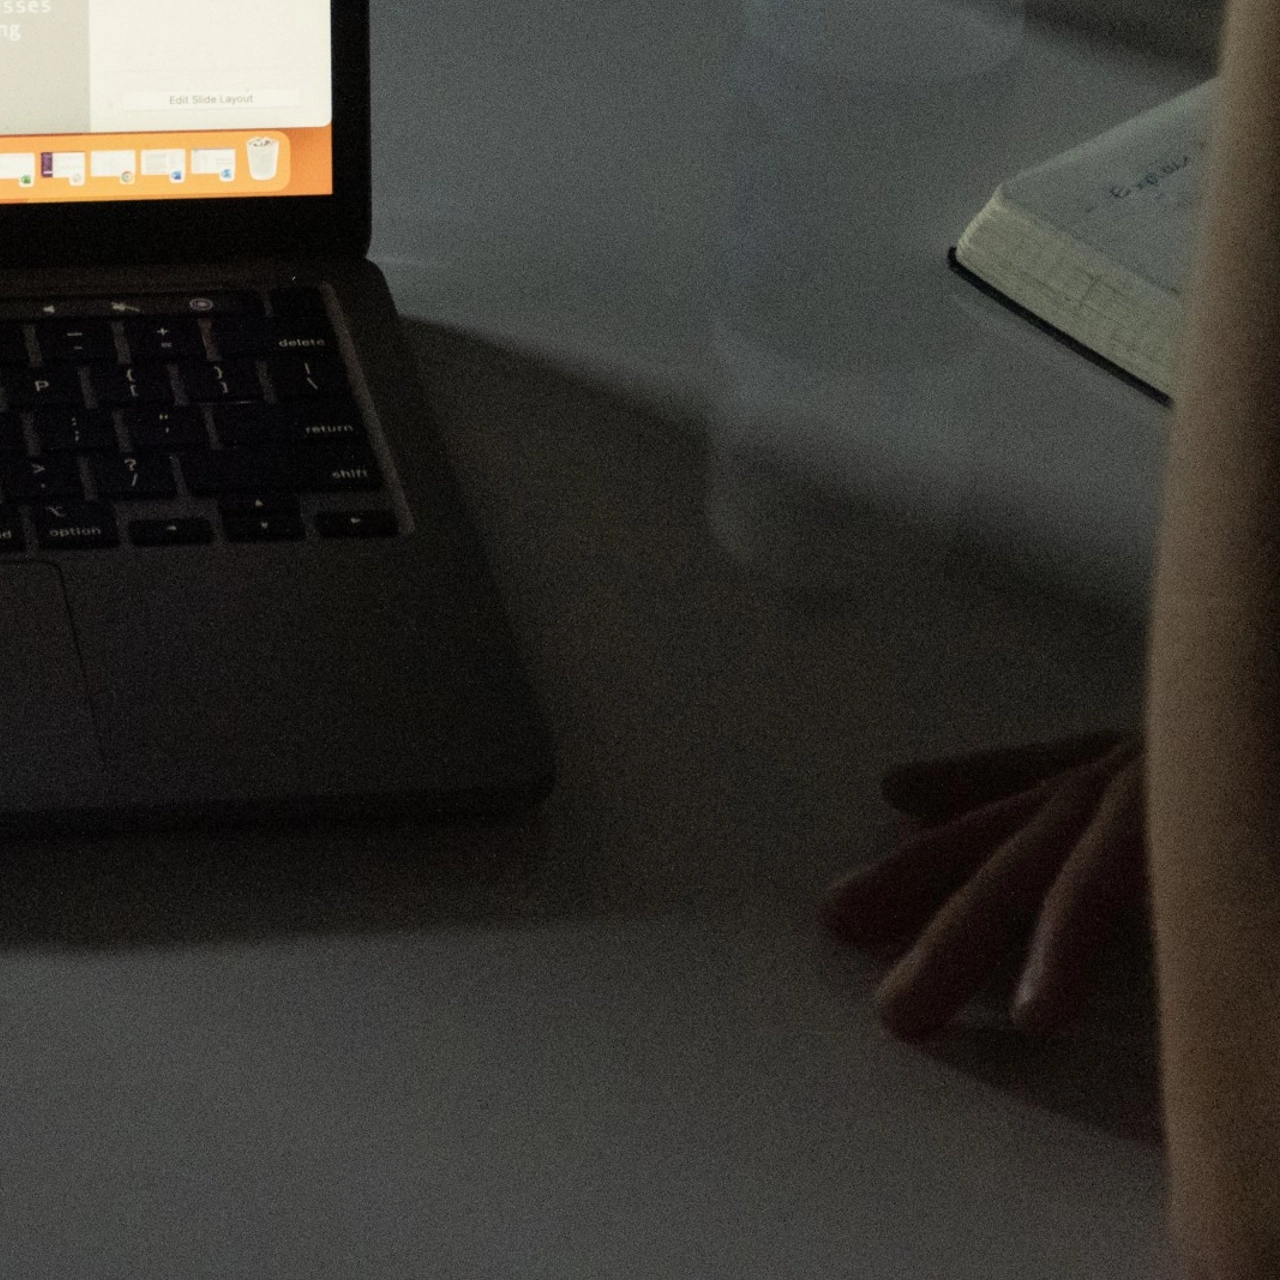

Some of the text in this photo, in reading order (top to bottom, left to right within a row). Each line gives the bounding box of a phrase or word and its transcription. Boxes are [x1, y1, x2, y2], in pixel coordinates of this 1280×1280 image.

[169, 94, 254, 107] Edit Slide Layout
[278, 338, 326, 349] delete
[34, 380, 50, 392] P
[305, 422, 354, 434] return
[331, 468, 368, 480] shift
[48, 525, 103, 538] option
